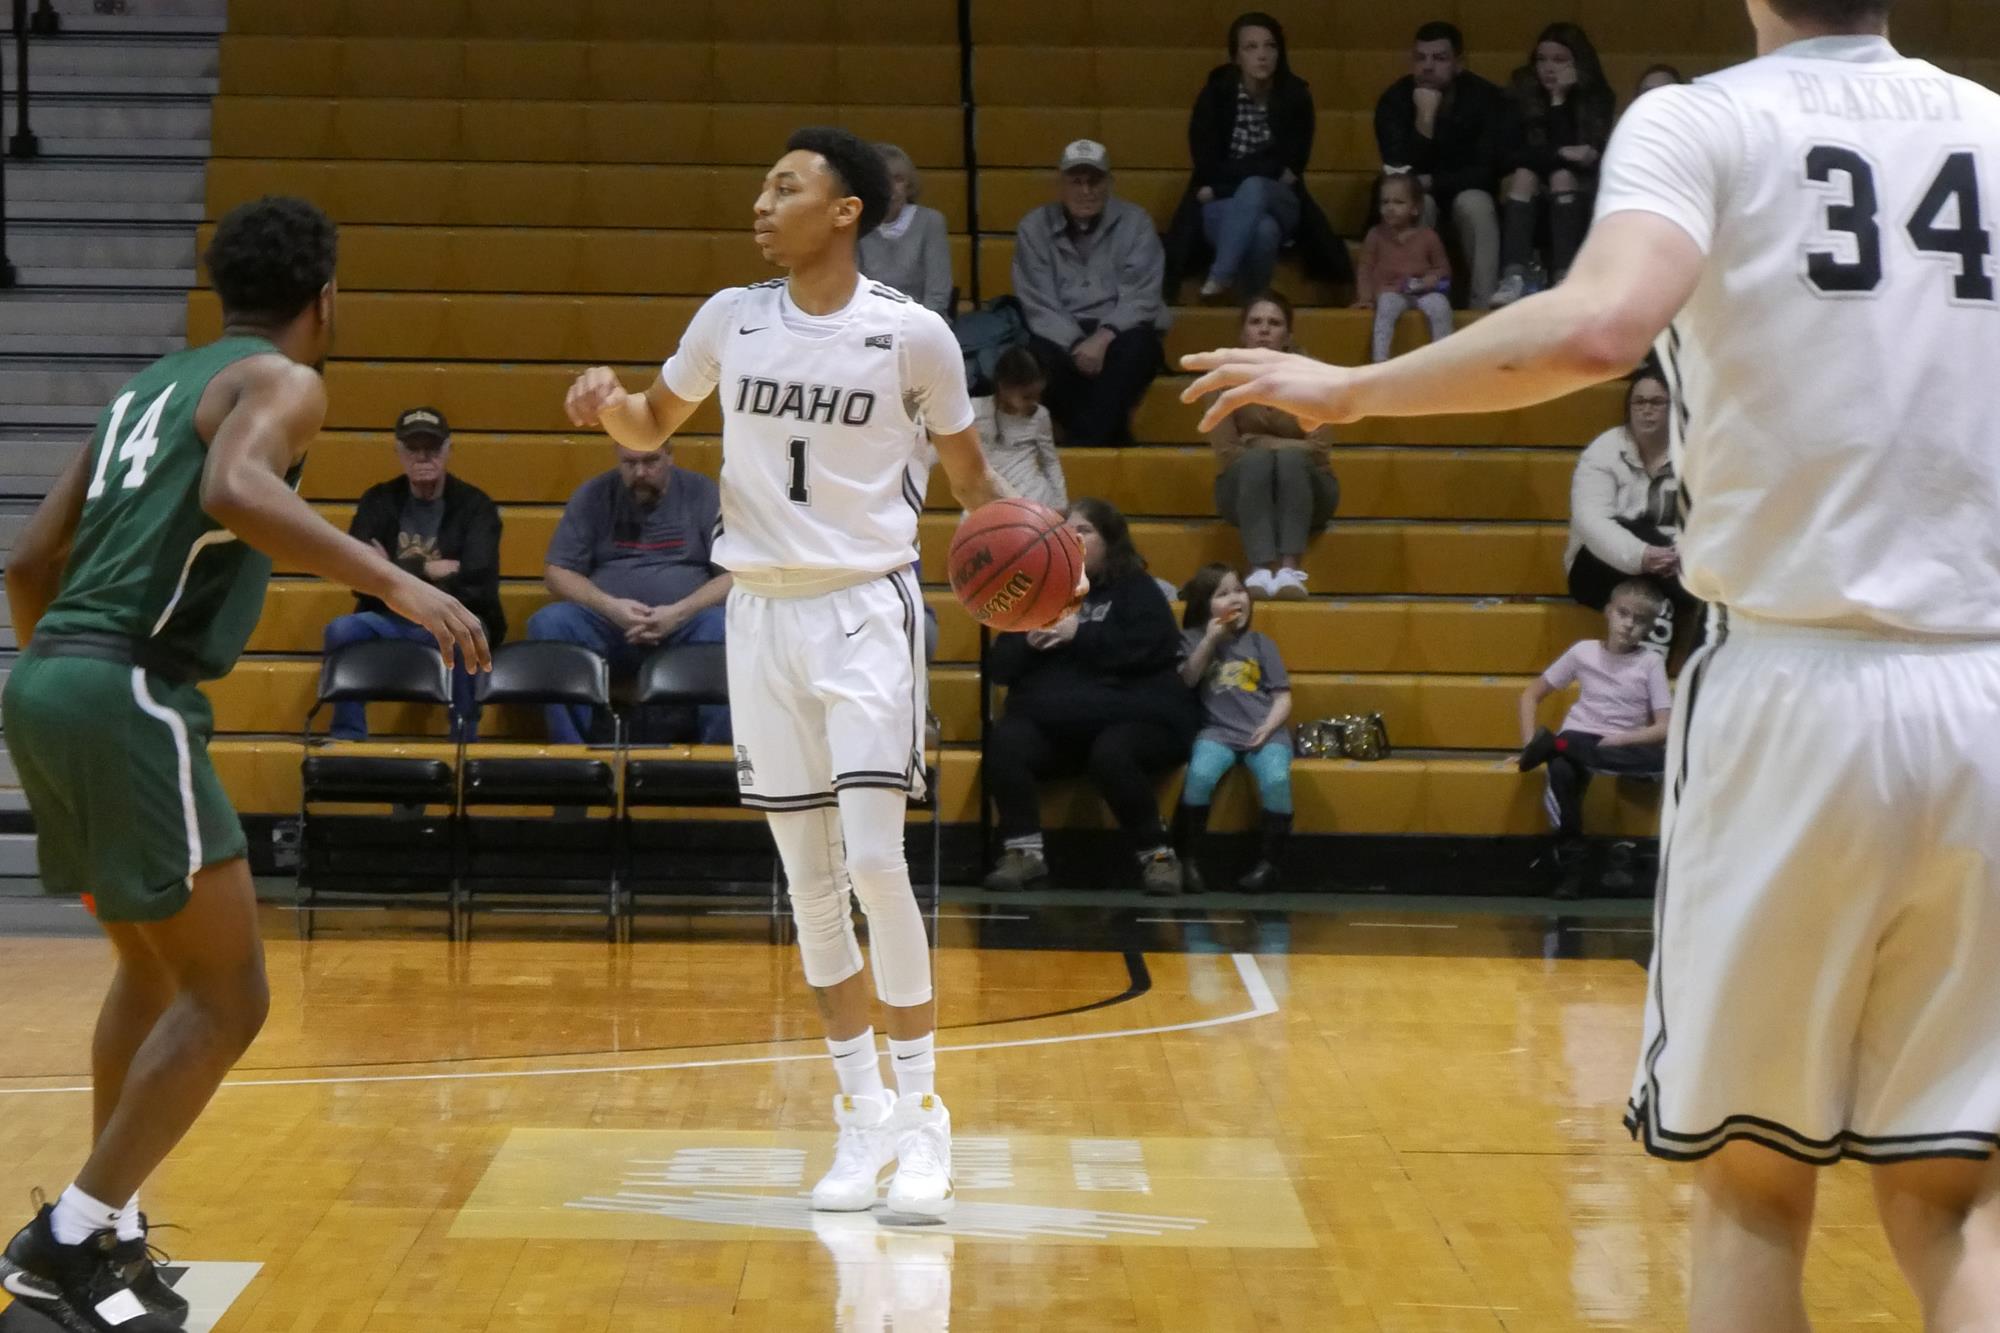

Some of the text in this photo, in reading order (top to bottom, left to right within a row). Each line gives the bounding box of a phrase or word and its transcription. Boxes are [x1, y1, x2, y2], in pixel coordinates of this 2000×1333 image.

[1789, 70, 1962, 121] BLAKNEY
[1801, 138, 2000, 308] 34
[734, 374, 877, 427] IDAHO
[86, 381, 178, 500] 14
[786, 435, 811, 507] 1
